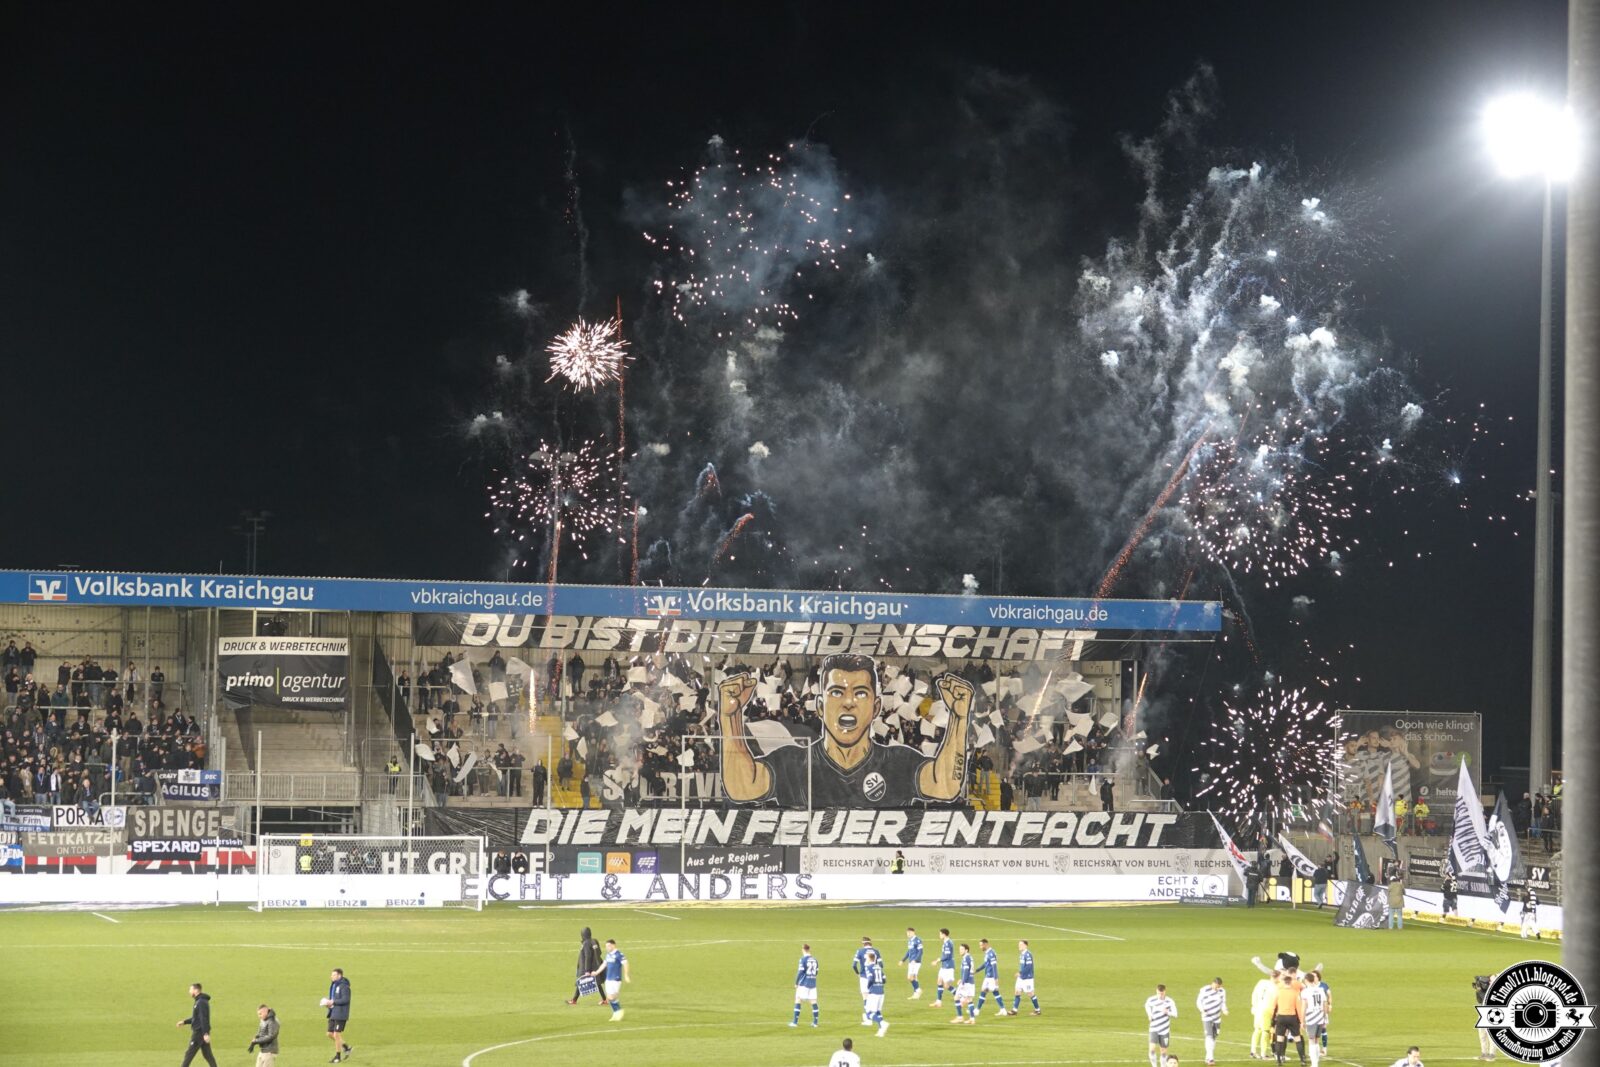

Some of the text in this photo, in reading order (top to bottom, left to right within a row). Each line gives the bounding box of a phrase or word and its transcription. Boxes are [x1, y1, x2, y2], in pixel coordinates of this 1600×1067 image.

[74, 576, 315, 606] Volksbank Kraichgau
[411, 588, 543, 610] vbkraichgau.de
[688, 591, 902, 619] Volksbank Kraichgau
[989, 605, 1109, 625] vbkraichgau.de
[460, 613, 1099, 662] DU BIST DIE LEIDENSCHAFT
[223, 641, 347, 653] DRUCK & WERBETECHNIK
[225, 672, 346, 693] primo agentur
[1395, 719, 1474, 732] Oooh wie klingt
[1404, 731, 1422, 741] das
[866, 775, 879, 789] SV
[161, 783, 210, 798] AGILUS
[55, 807, 105, 826] PORA
[134, 809, 220, 837] SPENGE
[520, 808, 1179, 848] DIE MEIN FEUER ENTFACHT
[27, 831, 122, 846] FETTKATZEN
[56, 846, 95, 856] ON TOUR
[132, 840, 201, 854] SPEXARD
[686, 857, 705, 868] Aus
[708, 854, 725, 865] der
[728, 852, 760, 866] Region
[823, 859, 875, 868] REICHSRAT
[950, 859, 1050, 868] REICHSRAT VON BUHL
[1073, 859, 1171, 868] REICHSRAT VON BUHL
[1158, 876, 1199, 885] ECHT &
[1531, 867, 1545, 881] SV
[460, 873, 827, 900] ECHT & ANDERS.
[1148, 888, 1199, 897] ANDERS.
[1312, 993, 1322, 1008] 14
